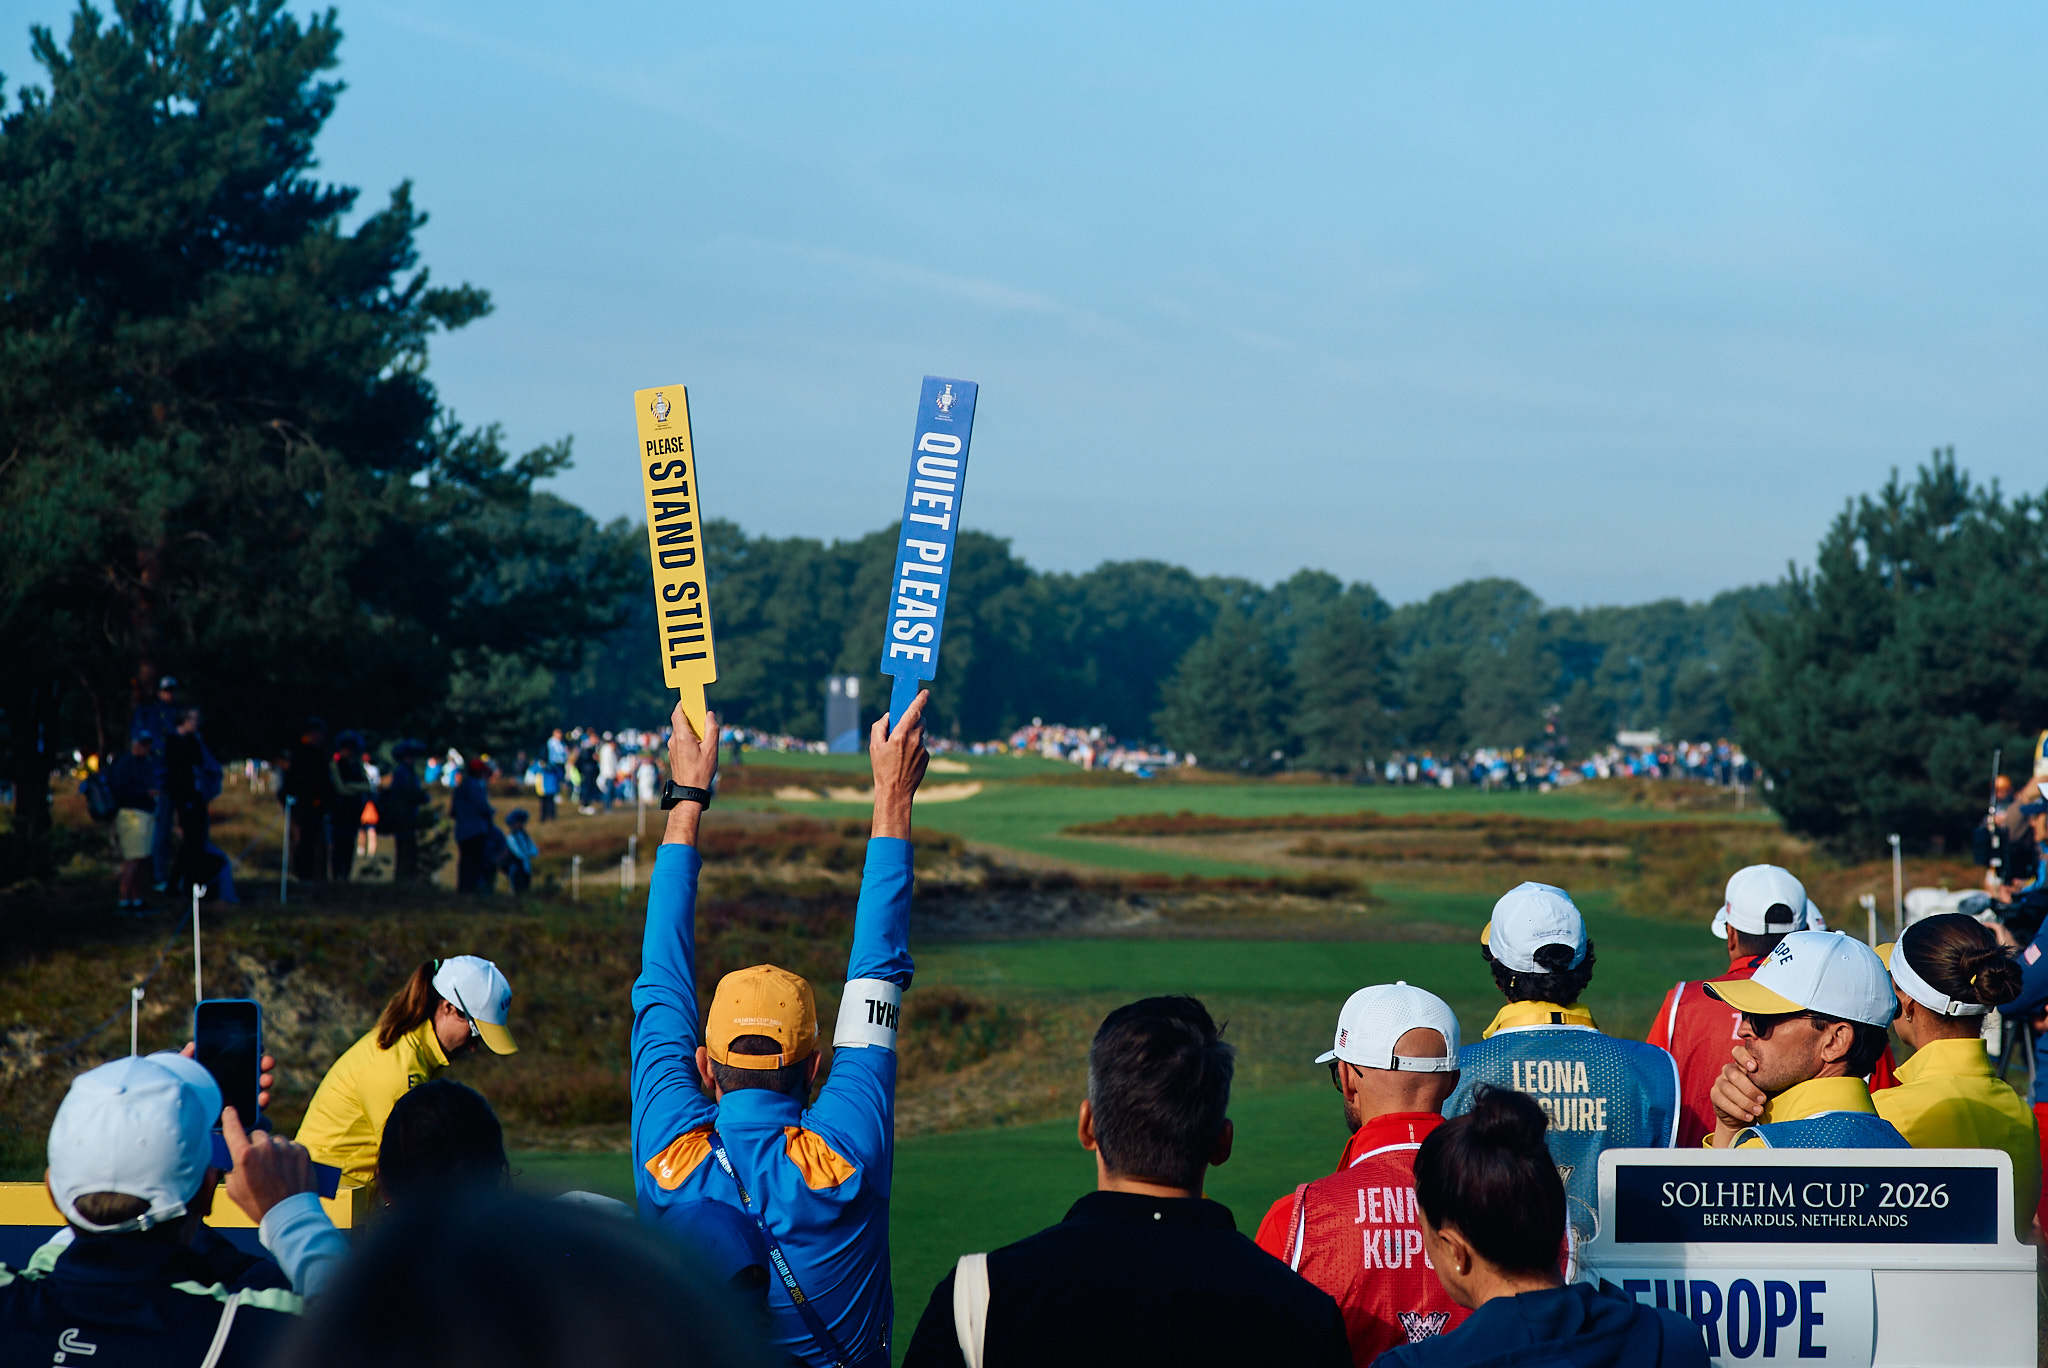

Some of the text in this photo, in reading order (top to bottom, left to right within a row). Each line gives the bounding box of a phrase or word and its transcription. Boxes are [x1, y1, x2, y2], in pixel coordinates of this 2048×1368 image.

[646, 436, 685, 456] PLEASE
[890, 432, 962, 663] QUIET PLEASE
[649, 460, 707, 669] STAND STILL
[1774, 942, 1793, 965] OPE
[1513, 1060, 1589, 1093] LEONA
[1661, 1182, 1949, 1208] SOLHEIM CUP 2026
[1703, 1213, 1908, 1228] BERNARDUS, NETHERLANDS
[770, 1248, 805, 1304] SOLHEIM CUP 2026
